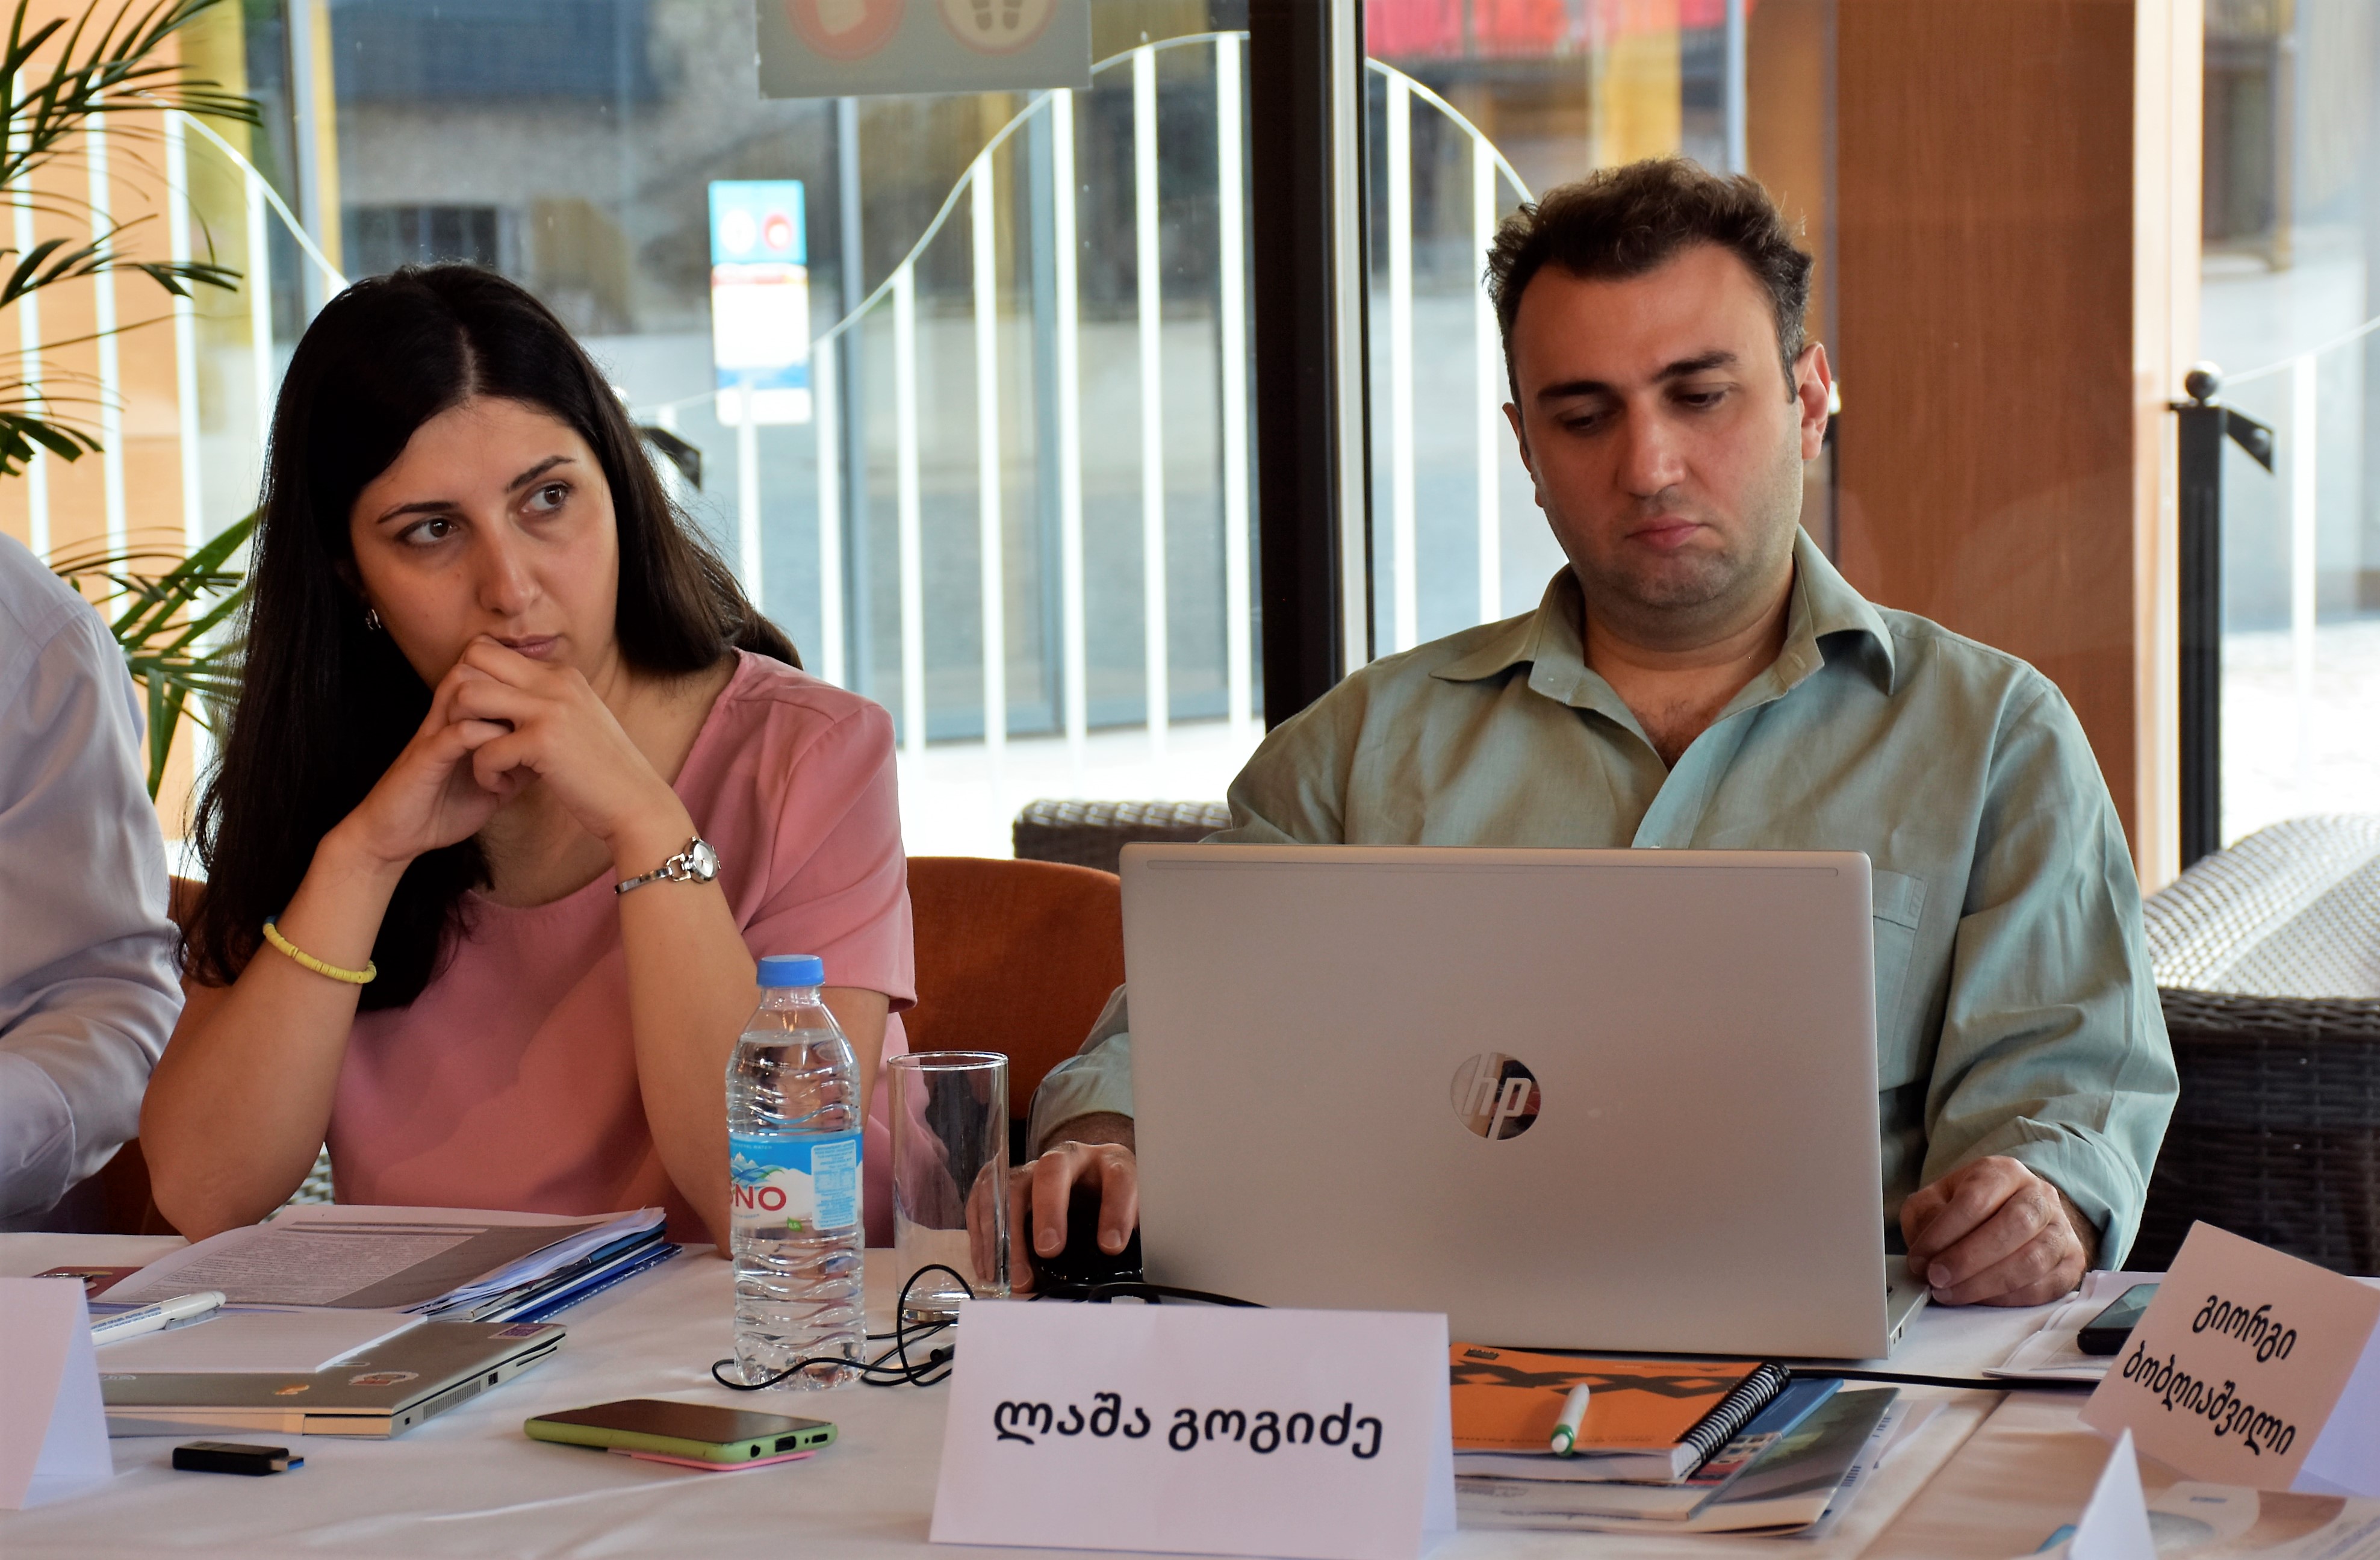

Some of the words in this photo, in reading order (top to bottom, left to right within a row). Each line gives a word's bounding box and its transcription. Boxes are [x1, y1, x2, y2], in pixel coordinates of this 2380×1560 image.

[1462, 1052, 1532, 1140] hp
[730, 1182, 787, 1211] NO
[2192, 1294, 2297, 1363] გიორგი
[993, 1392, 1151, 1445] ლაშა
[1168, 1402, 1383, 1459] გოგიძე
[2122, 1340, 2296, 1456] ბობღიაშვილი
